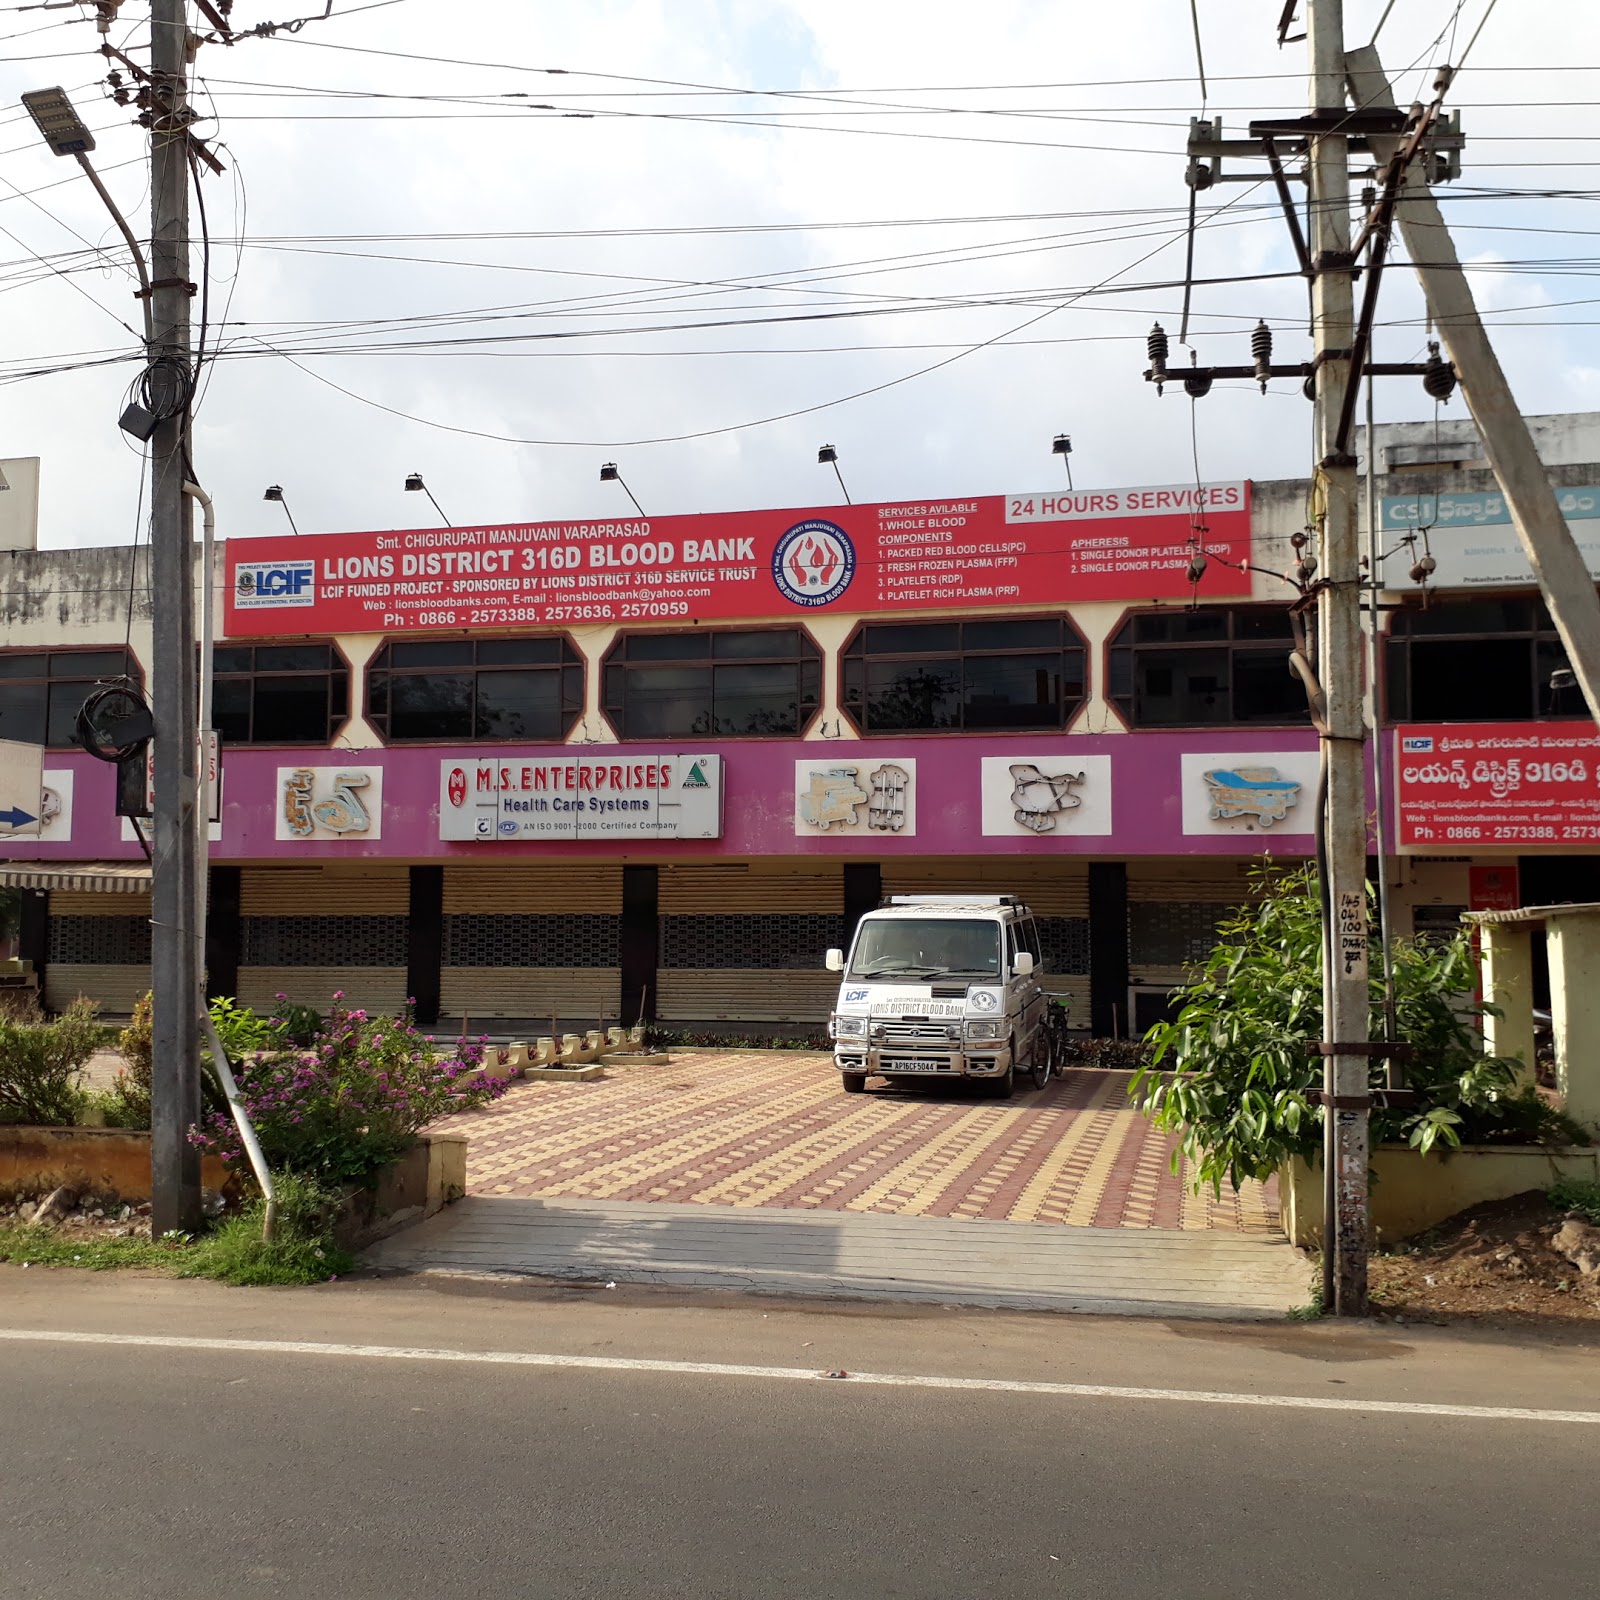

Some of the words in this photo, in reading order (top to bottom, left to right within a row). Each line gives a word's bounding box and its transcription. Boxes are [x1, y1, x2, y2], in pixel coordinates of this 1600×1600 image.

[878, 506, 927, 517] SERVICES
[929, 503, 978, 514] AVILABLE
[1011, 499, 1035, 517] 24
[1042, 494, 1119, 515] HOURS
[1126, 487, 1239, 510] SERVICES
[1389, 503, 1430, 520] CSI
[804, 523, 836, 535] MANJUVANI
[878, 519, 926, 531] 1.WHOLE
[928, 517, 967, 528] BLOOD
[376, 536, 402, 550] Smt.
[405, 532, 486, 548] CHIGURUPATI
[489, 527, 561, 544] MANJUVANI
[564, 522, 650, 540] VARAPRASAD
[878, 532, 953, 545] COMPONENTS
[1071, 537, 1129, 548] APHERESIS
[323, 556, 395, 580] LIONS
[402, 549, 515, 577] DISTRICT
[521, 546, 582, 571] 316D
[589, 542, 675, 568] BLOOD
[683, 537, 756, 562] BANK
[878, 550, 886, 559] 1.
[887, 548, 923, 559] PACKED
[925, 547, 943, 556] RED
[945, 545, 977, 556] BLOOD
[979, 542, 1026, 553] CELLS(PC)
[1080, 550, 1114, 561] SINGLE
[1115, 549, 1149, 559] DONOR
[1204, 544, 1231, 556] (SDP)
[878, 564, 886, 573] 2.
[887, 562, 917, 572] FRESH
[918, 560, 954, 571] FROZEN
[956, 558, 993, 569] PLASMA
[994, 556, 1018, 568] (FFP)
[1080, 563, 1114, 573] SINGLE
[1115, 561, 1149, 571] DONOR
[1150, 560, 1189, 570] PLASMA
[256, 569, 313, 596] LCIF
[321, 585, 344, 599] LCIF
[347, 583, 391, 598] FUNDED
[394, 581, 443, 596] PROJECT
[452, 578, 520, 593] SPONSORED
[523, 576, 538, 590] BY
[541, 575, 576, 589] LIONS
[578, 573, 631, 587] DISTRICT
[634, 571, 662, 585] 316D
[665, 569, 715, 583] SERVICE
[718, 567, 758, 581] TRUST
[878, 578, 886, 587] 3.
[887, 575, 937, 587] PLATELETS
[938, 574, 963, 585] (RDP)
[363, 600, 387, 610] Web
[394, 596, 510, 611] lionsbloodbanks.com,
[513, 593, 547, 605] E-mail
[555, 587, 711, 603] lionsbloodbank@yahoo.com
[783, 587, 808, 605] DISTRICT
[808, 597, 826, 606] 316D
[825, 585, 844, 601] BLOOD
[878, 592, 886, 601] 4.
[887, 589, 931, 601] PLATELET
[933, 588, 955, 598] RICH
[956, 587, 993, 597] PLASMA
[995, 586, 1020, 597] (PRP)
[384, 613, 404, 626] Ph
[419, 611, 456, 625] 0866
[470, 607, 540, 624] 2573388,
[545, 604, 616, 621] 2573636,
[621, 601, 689, 617] 2570959
[1525, 758, 1587, 783] 316డి
[503, 797, 548, 812] Health
[553, 797, 585, 812] Care
[589, 796, 650, 814] Systems
[536, 822, 552, 831] ISO
[600, 821, 637, 830] Certified
[639, 820, 678, 832] Company
[1414, 826, 1434, 839] Ph
[1446, 826, 1482, 839] 0866
[1493, 825, 1559, 840] 2573388,
[1342, 921, 1362, 932] 100
[845, 990, 869, 1001] LCIF
[870, 1003, 889, 1014] LIONS
[890, 1003, 921, 1014] DISTRICT
[922, 1004, 944, 1015] BLOOD
[945, 1005, 965, 1016] BANK
